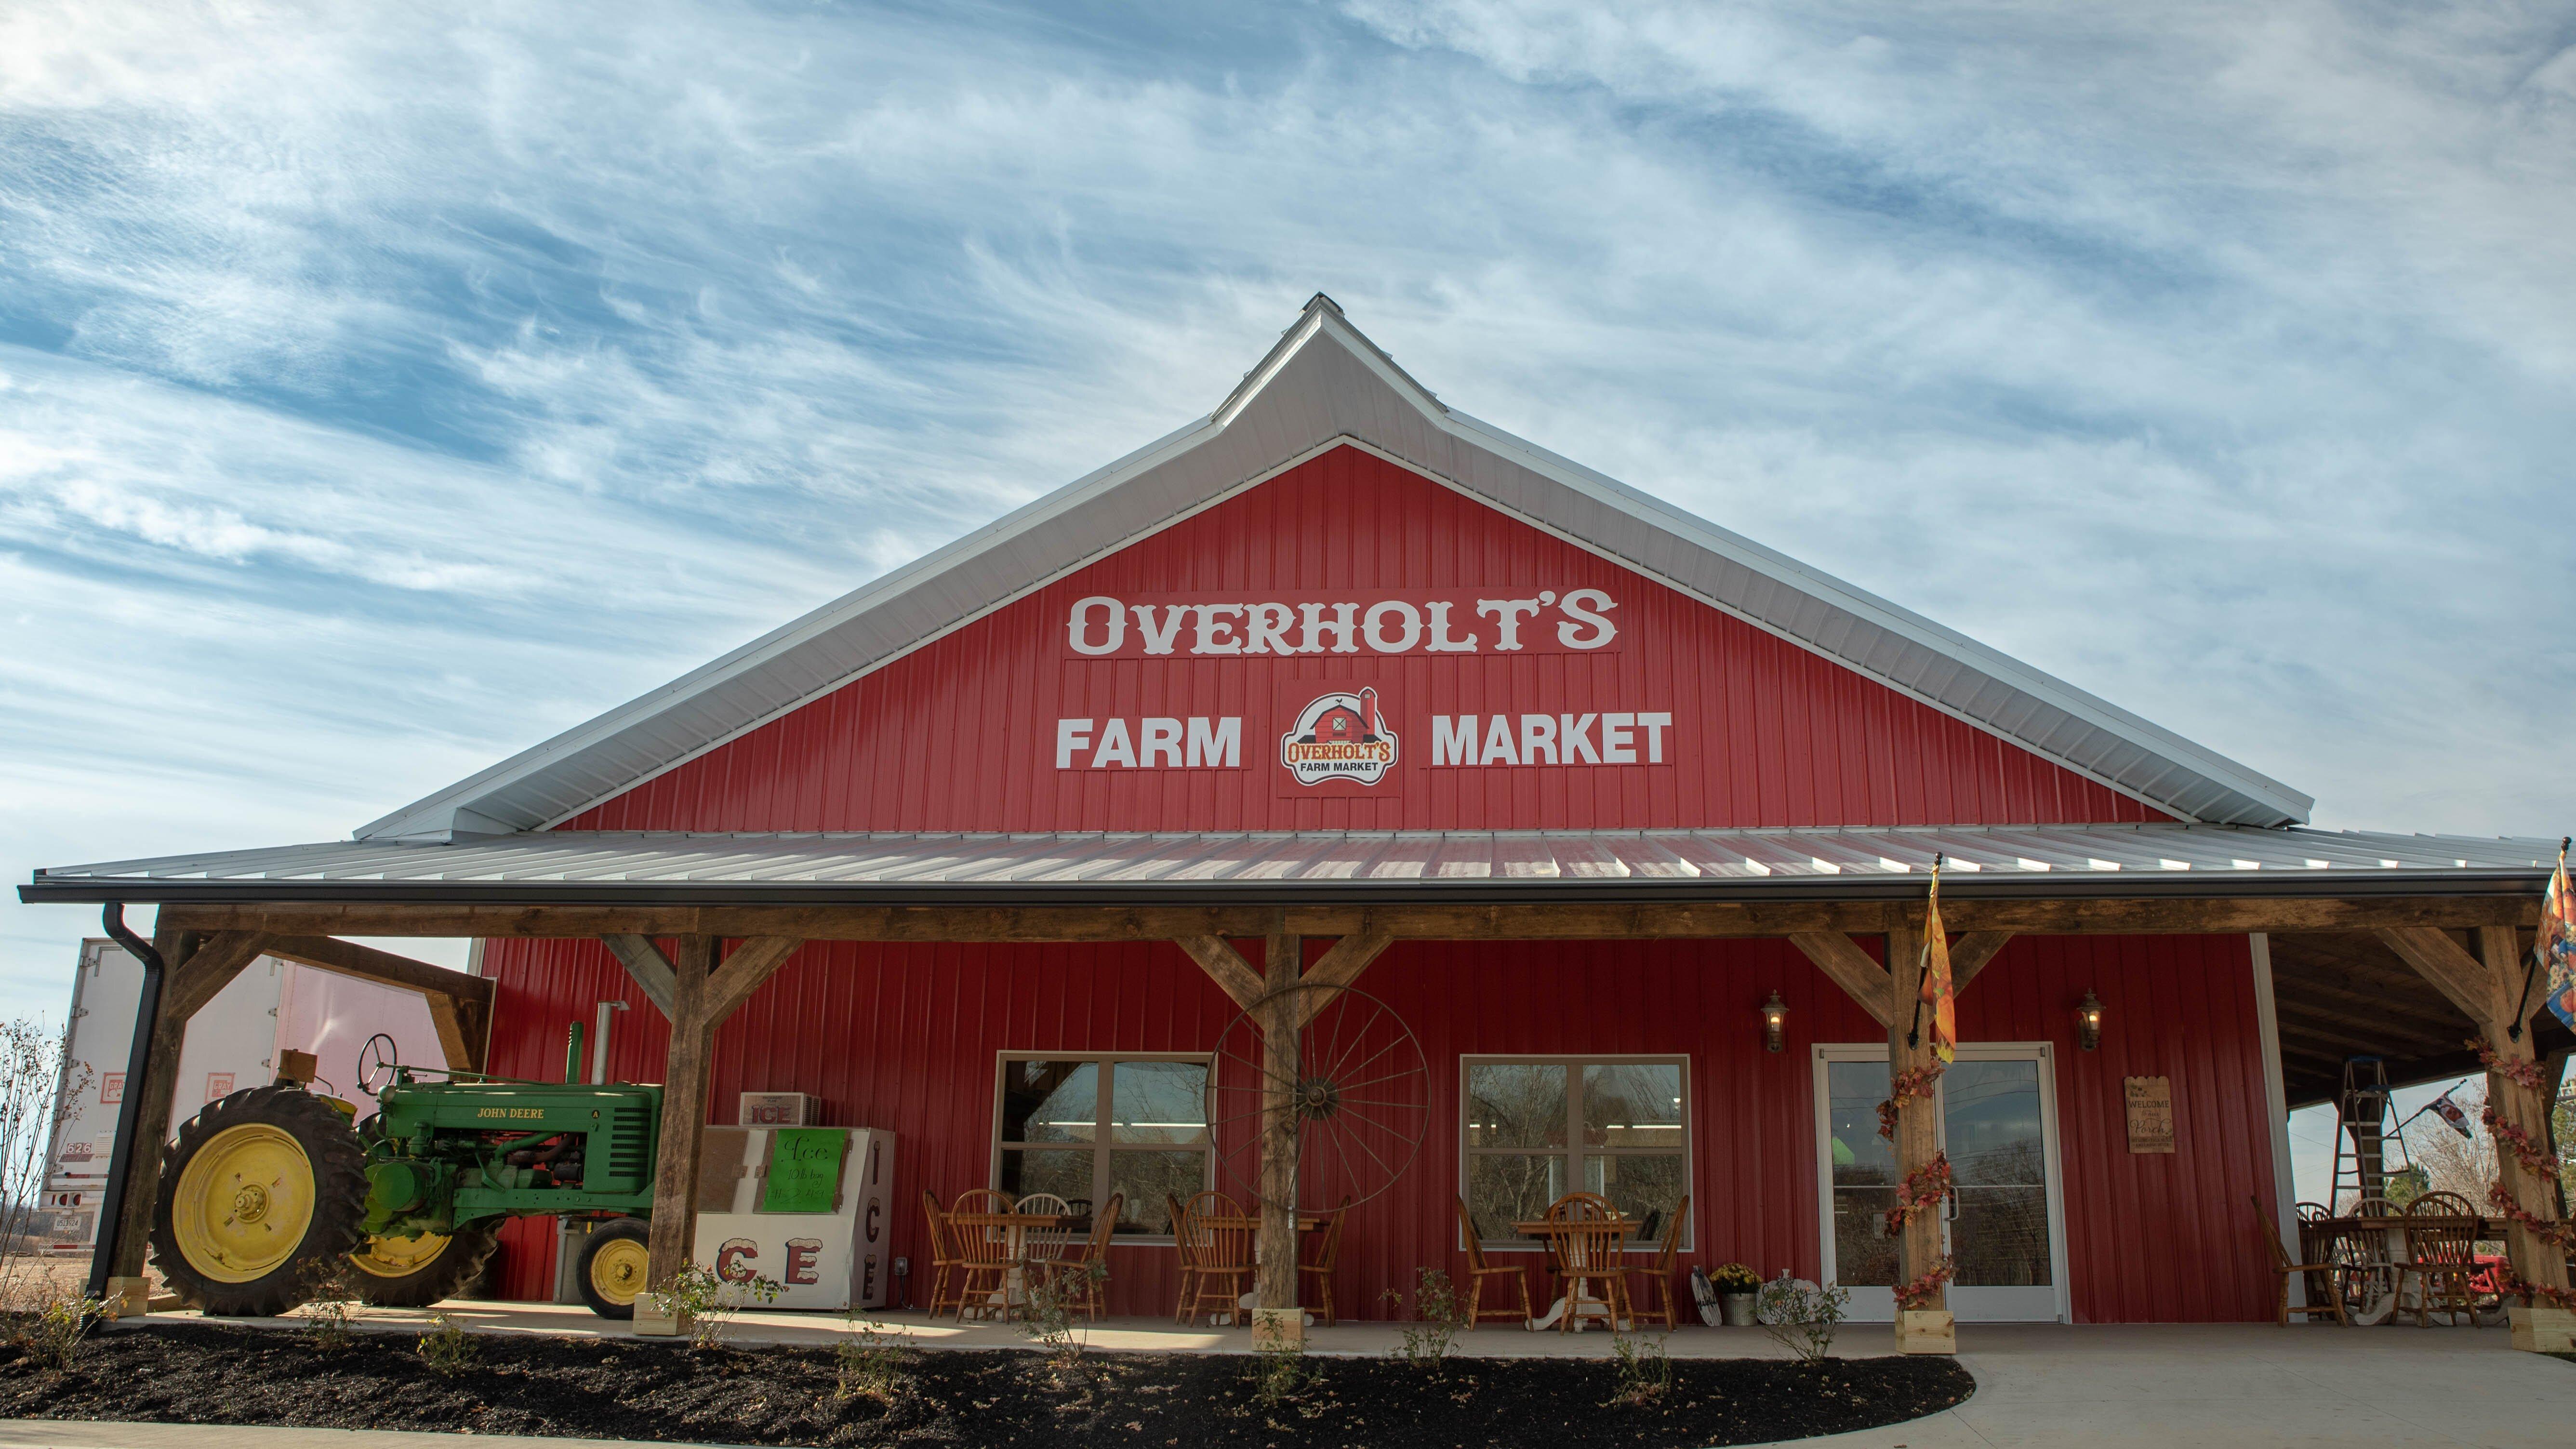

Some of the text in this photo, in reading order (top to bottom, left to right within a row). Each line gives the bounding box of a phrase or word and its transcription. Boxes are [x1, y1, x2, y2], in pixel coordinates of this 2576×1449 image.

[1066, 589, 1619, 655] OVERHOLT'S
[1057, 718, 1241, 767] FARM
[1431, 712, 1672, 767] MARKET
[1288, 742, 1391, 762] OVERHOLT'S
[1300, 762, 1378, 771] FARM MARKET
[477, 1108, 544, 1118] JOHN DEERE
[752, 1105, 792, 1123] ICE
[2129, 1118, 2171, 1134] Porch
[67, 1143, 91, 1153] 626
[864, 1141, 880, 1300] ICE
[717, 1238, 823, 1284] CE
